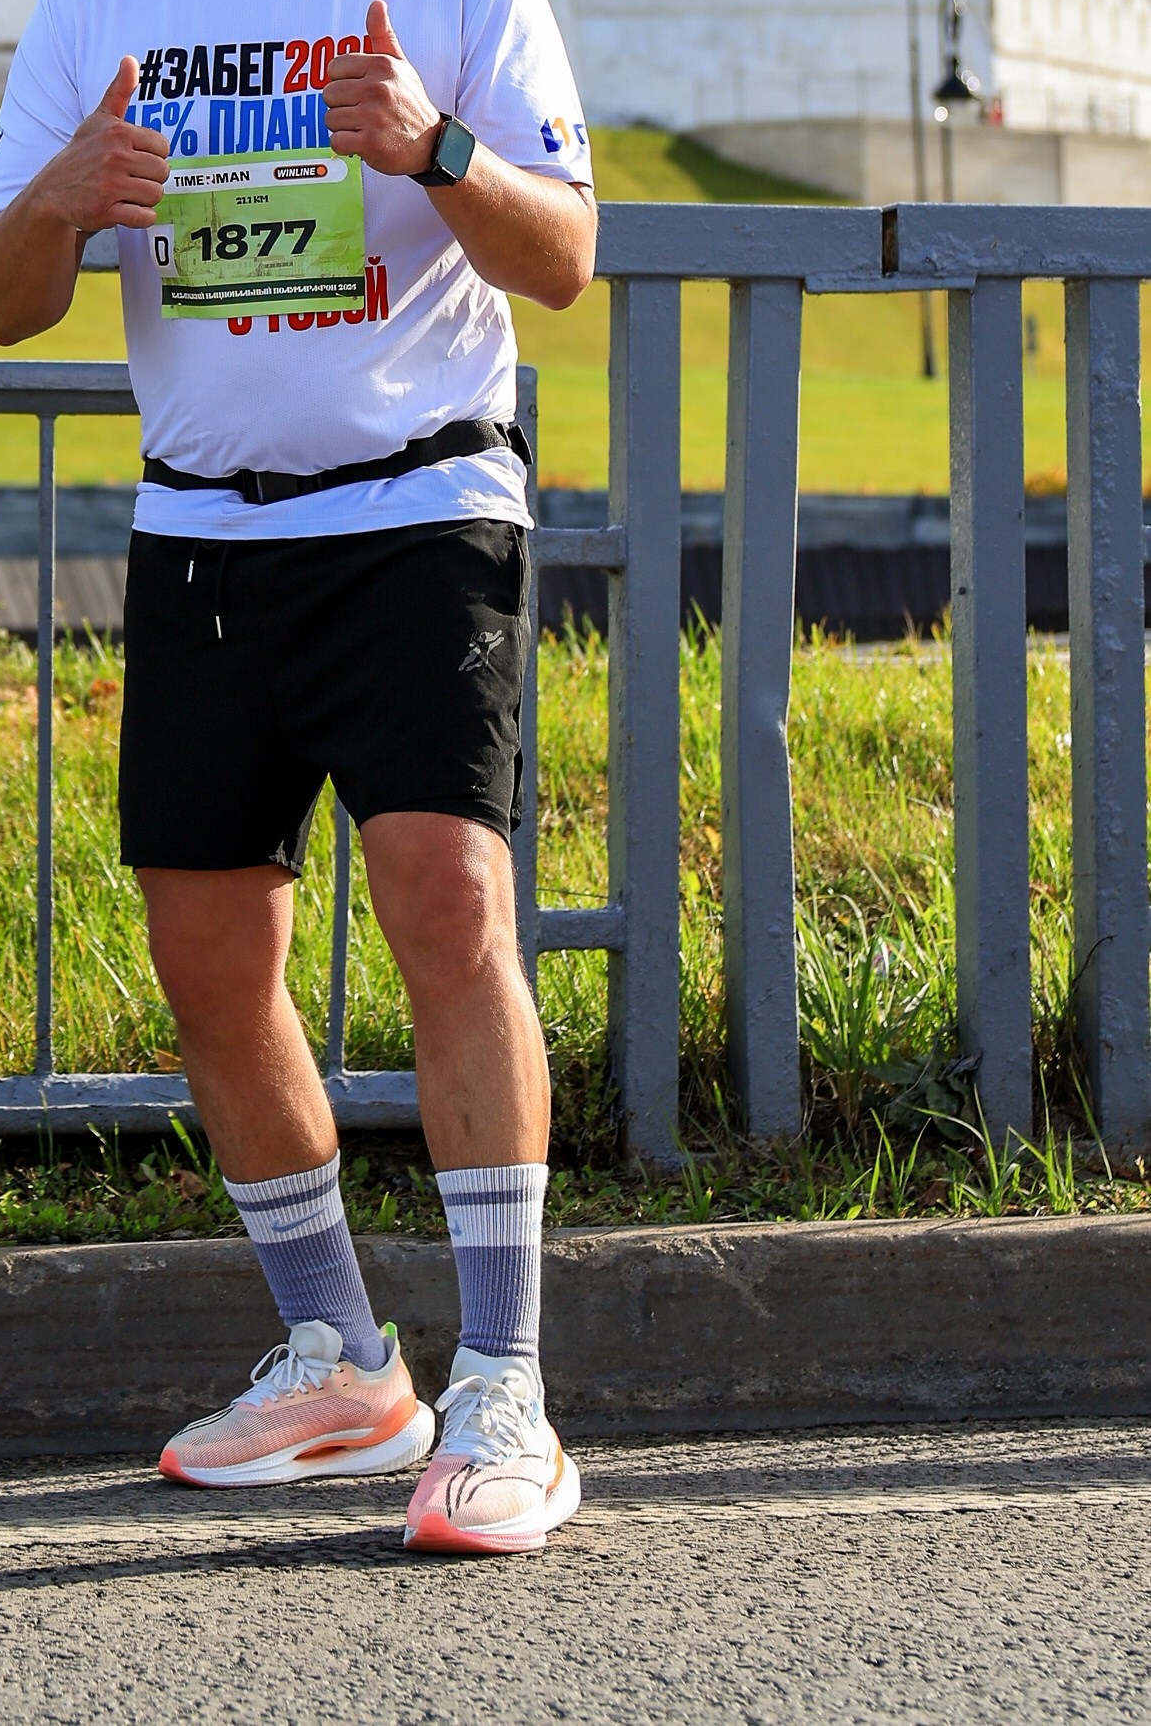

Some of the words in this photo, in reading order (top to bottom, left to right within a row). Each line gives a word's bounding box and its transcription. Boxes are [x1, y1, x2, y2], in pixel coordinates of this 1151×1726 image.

[277, 167, 316, 178] WINLINE
[235, 196, 251, 205] 21.1
[190, 219, 317, 262] 1877
[273, 284, 337, 294] ПОЛУМАРАФОН
